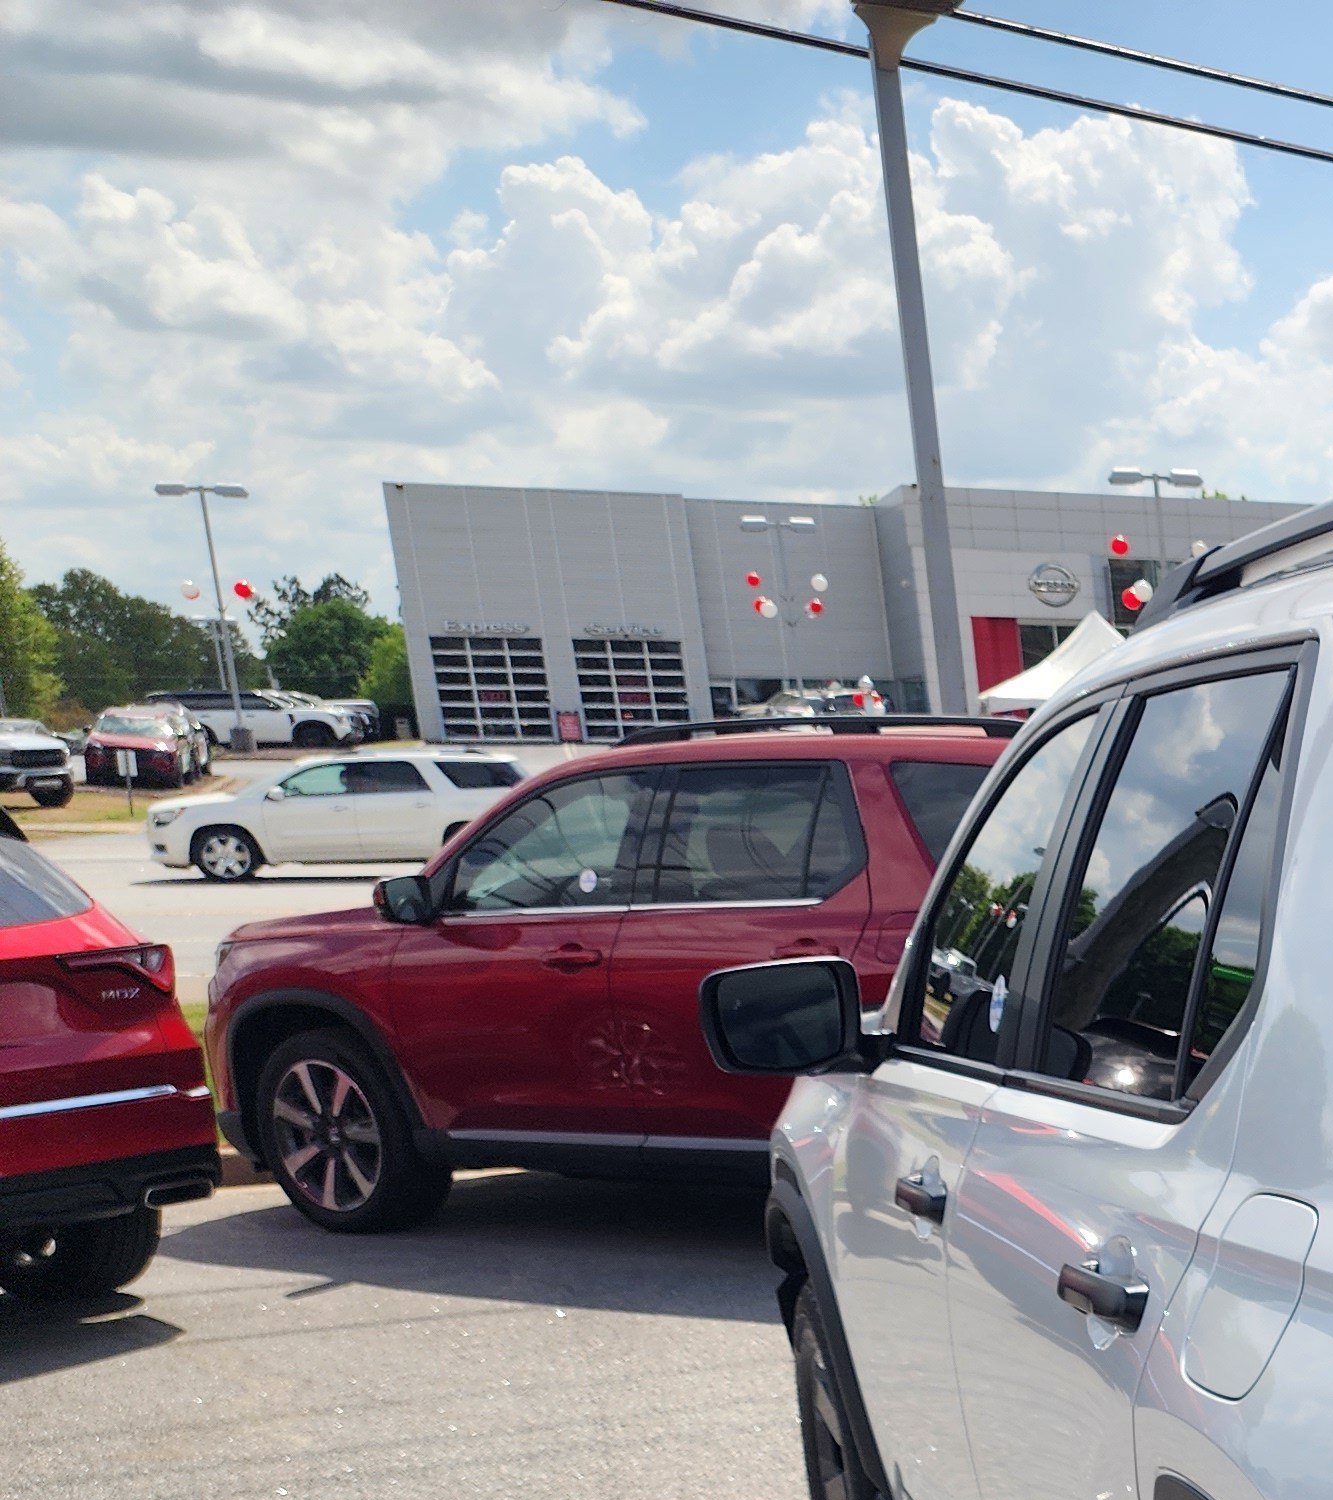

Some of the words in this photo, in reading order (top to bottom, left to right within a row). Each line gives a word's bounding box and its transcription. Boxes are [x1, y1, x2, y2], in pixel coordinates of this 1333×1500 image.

[444, 621, 528, 637] Express
[585, 622, 664, 636] Service
[102, 987, 140, 1001] MDX
